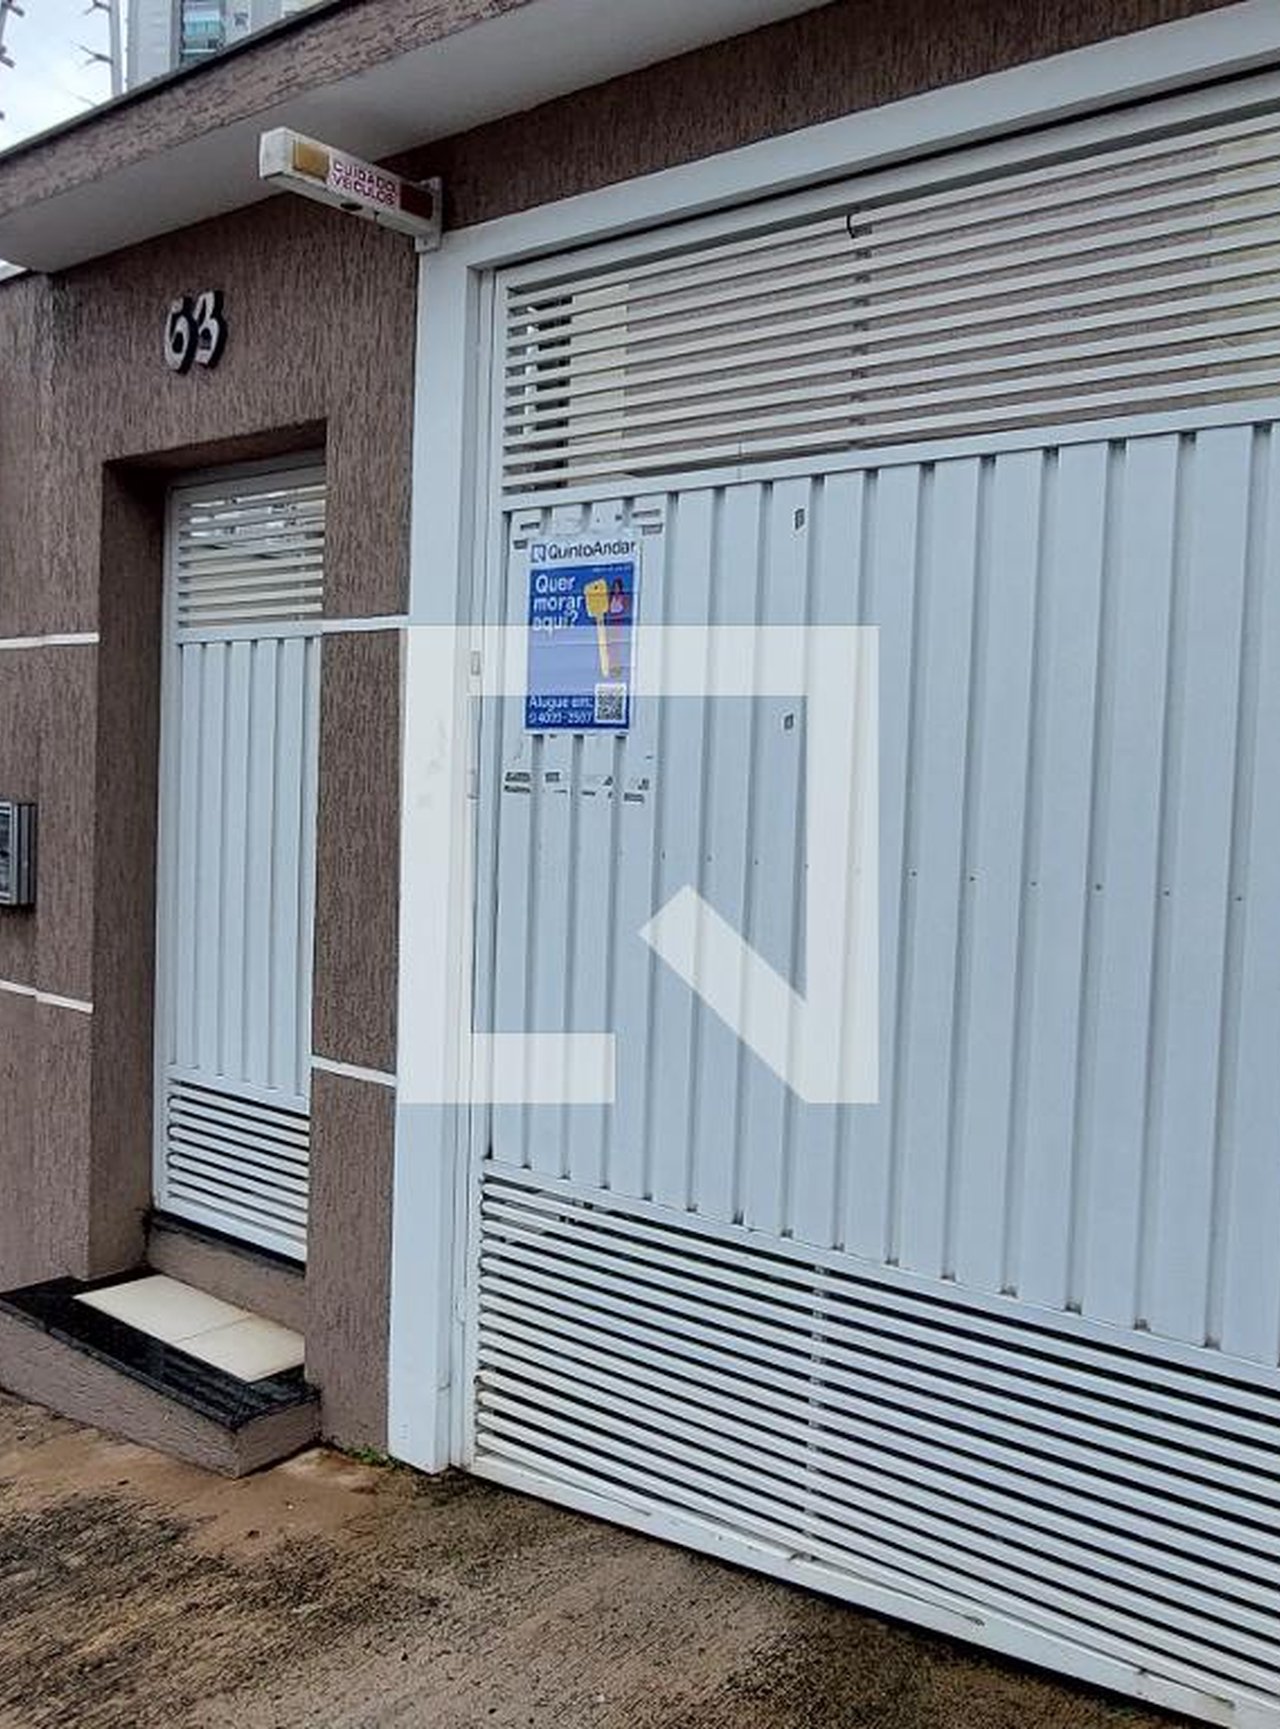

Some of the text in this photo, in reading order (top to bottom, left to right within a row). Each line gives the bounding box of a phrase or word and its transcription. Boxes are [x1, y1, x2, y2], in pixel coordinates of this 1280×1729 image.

[333, 161, 396, 194] CUIDADO
[164, 290, 224, 373] 63
[548, 540, 635, 560] QuintoAndar
[535, 574, 576, 594] Quer
[533, 595, 584, 613] morar
[532, 609, 578, 637] aqui?
